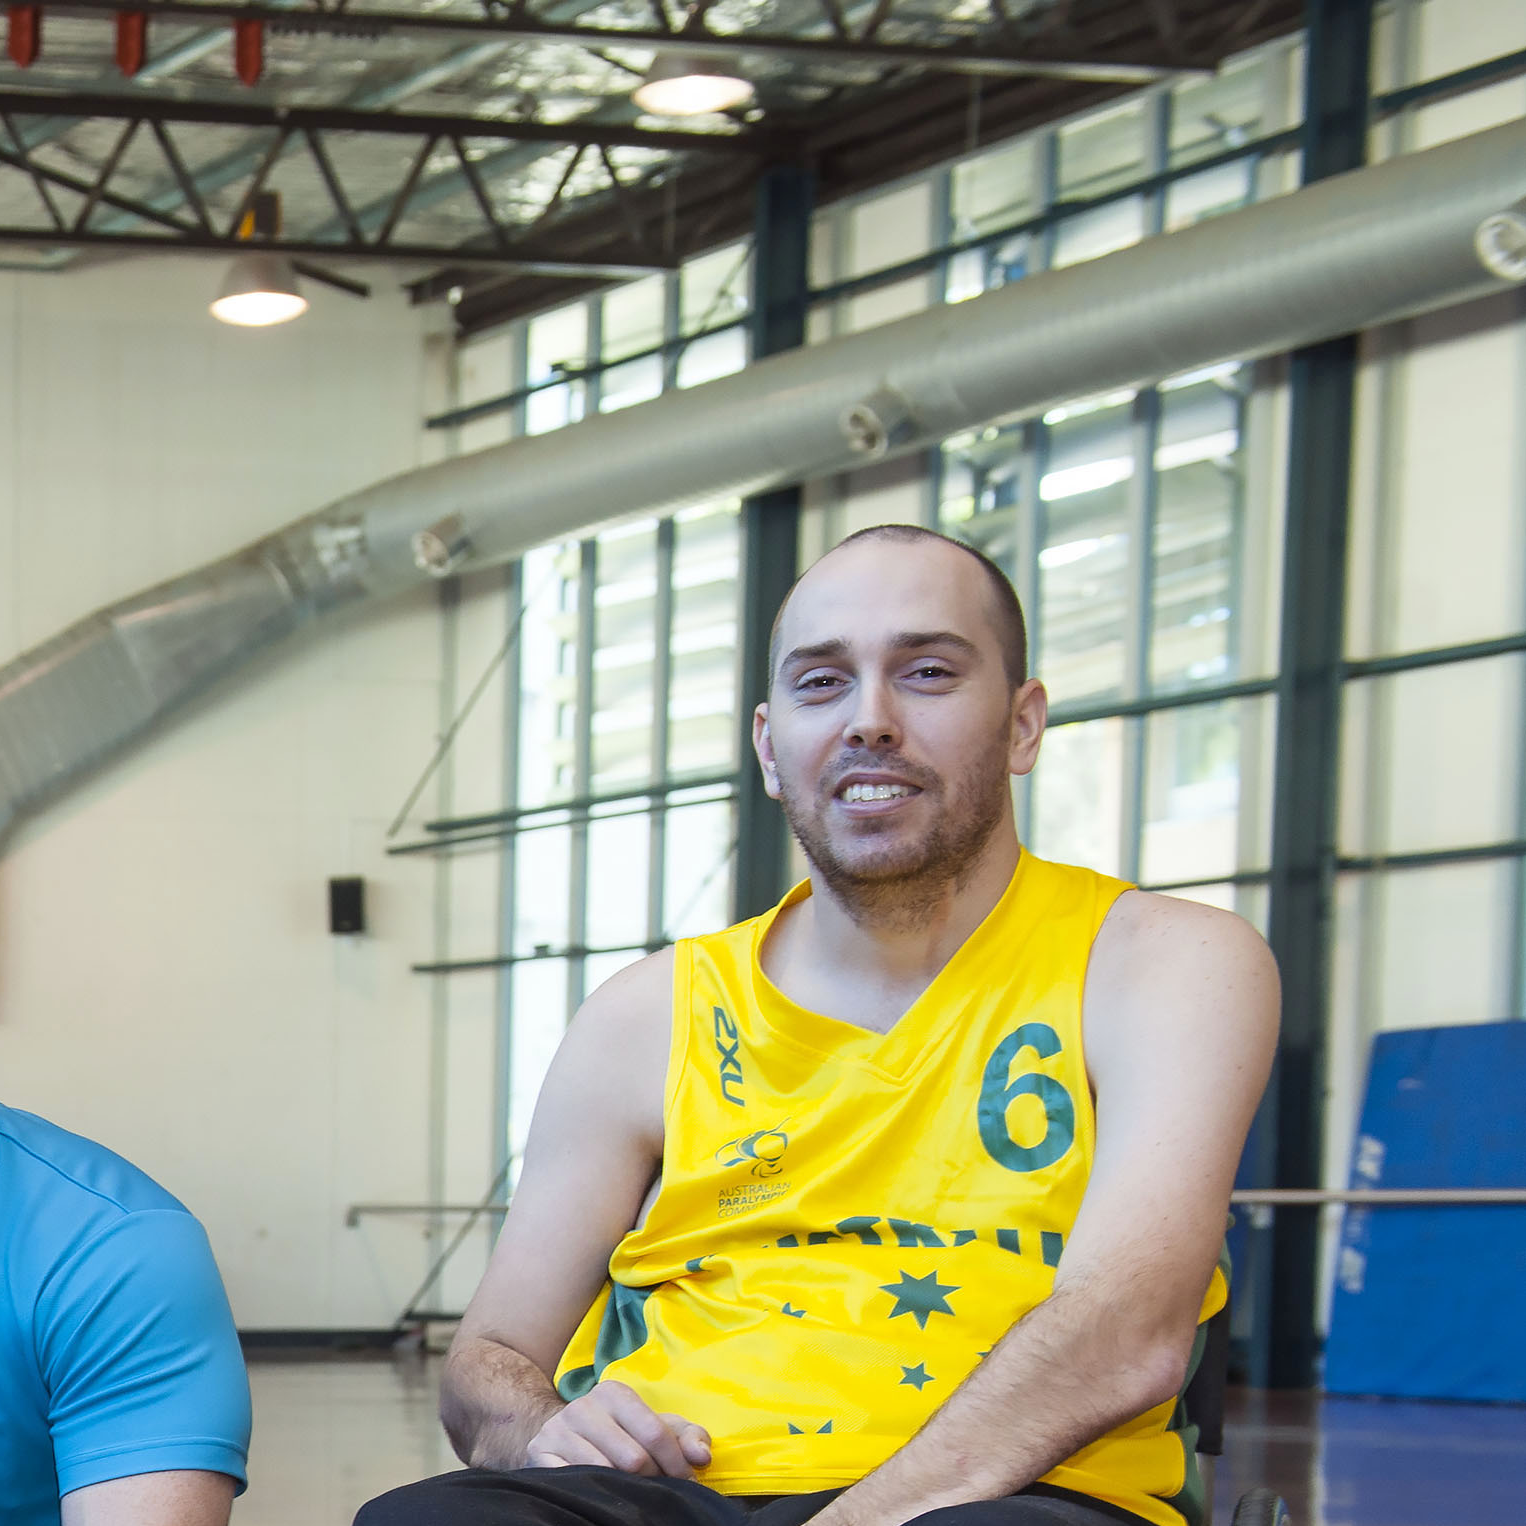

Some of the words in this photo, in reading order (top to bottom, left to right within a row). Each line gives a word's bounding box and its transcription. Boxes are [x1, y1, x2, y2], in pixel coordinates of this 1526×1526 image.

[713, 1006, 745, 1107] 2XU
[977, 1022, 1075, 1173] 6
[718, 1181, 792, 1198] AUSTRALIAN
